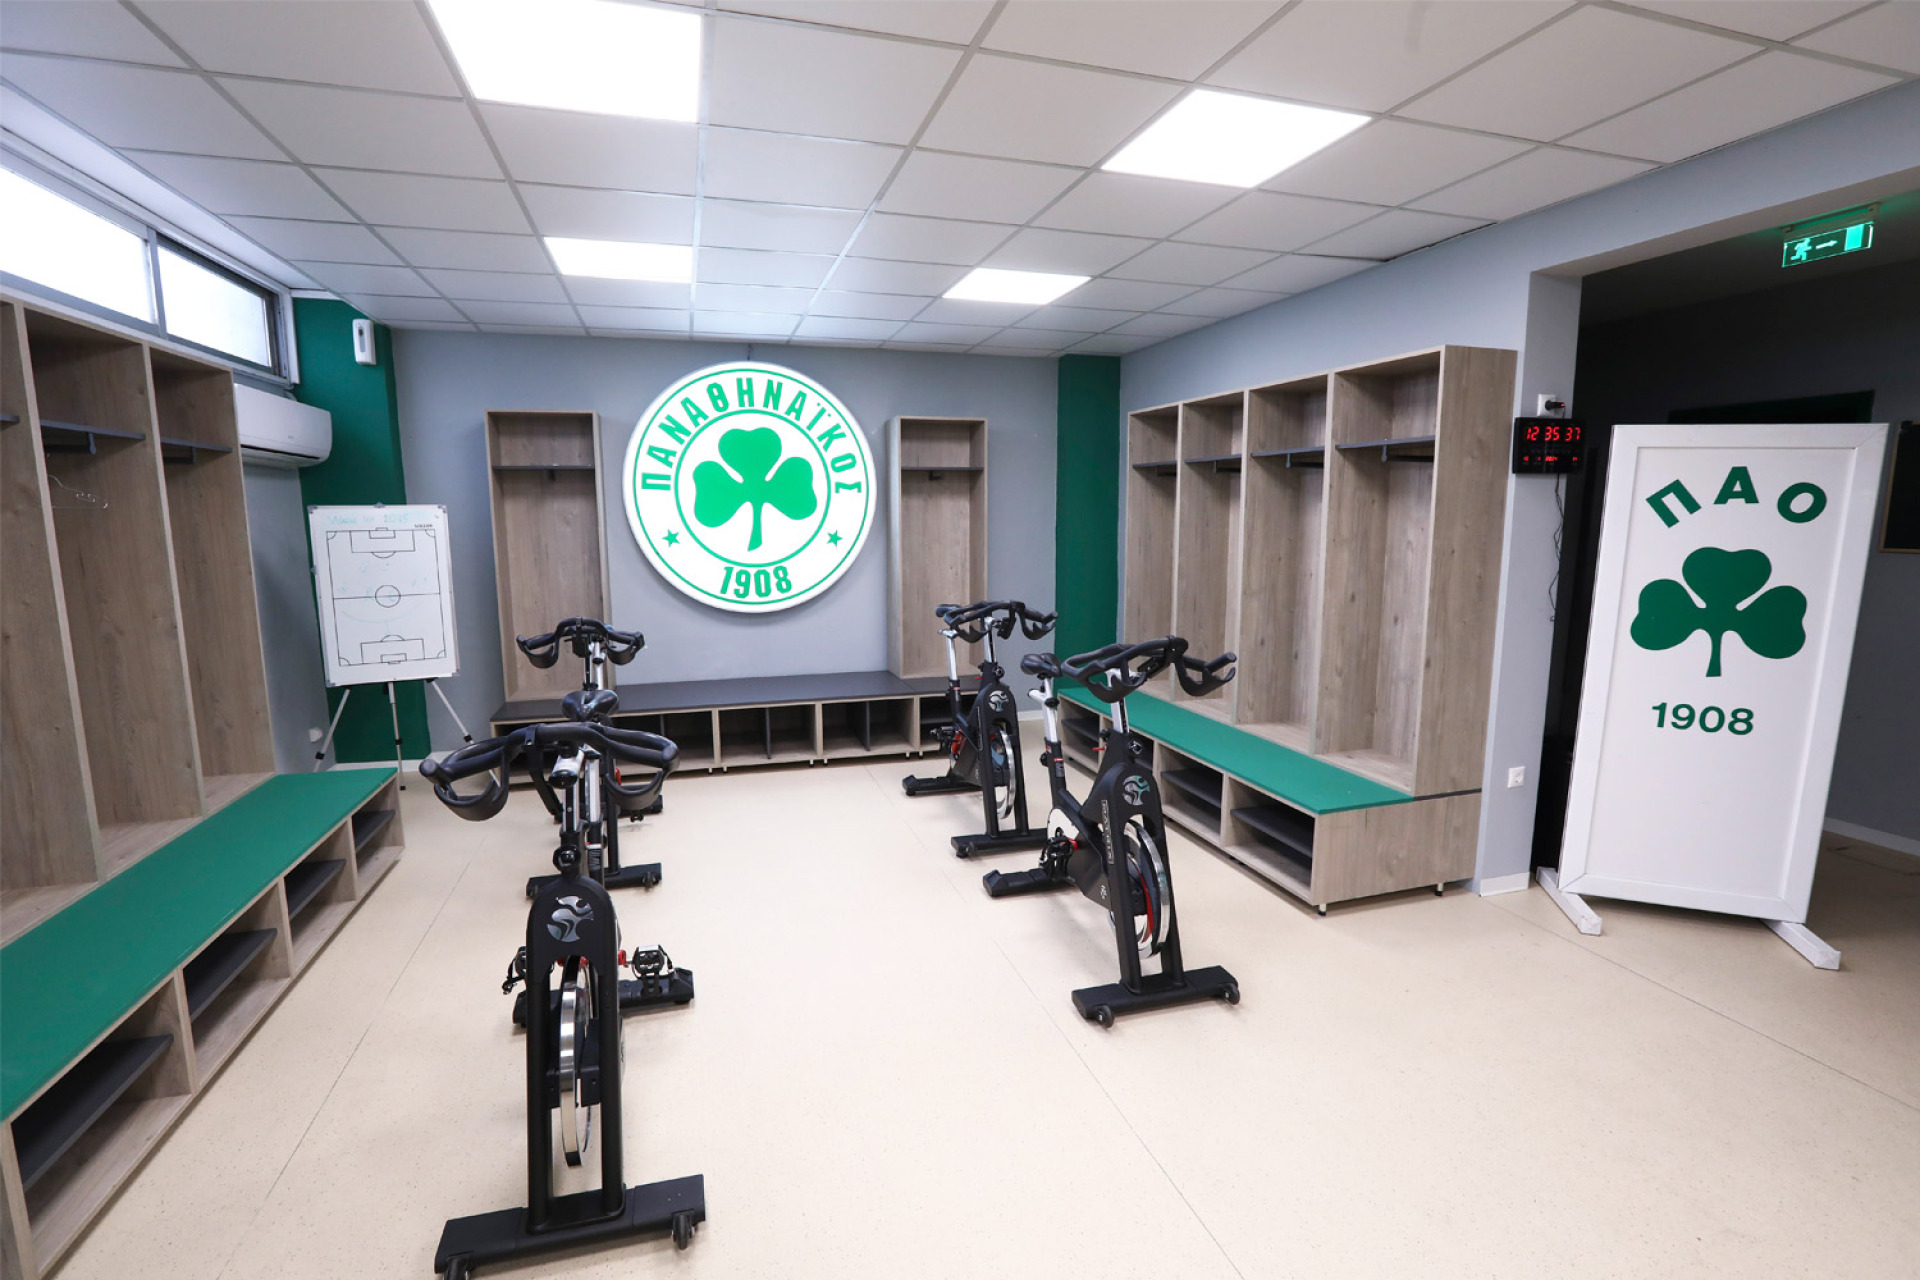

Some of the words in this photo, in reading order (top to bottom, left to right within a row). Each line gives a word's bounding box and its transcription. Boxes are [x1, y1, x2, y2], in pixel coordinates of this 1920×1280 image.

[641, 377, 862, 494] ΠΑΝΑΘΗΝΑΪΚΟΣ
[1526, 426, 1540, 441] 12
[1544, 426, 1560, 441] 35
[1564, 427, 1581, 442] 37
[1645, 466, 1827, 528] ΠΑΟ
[719, 565, 793, 599] 1908
[1652, 702, 1754, 736] 1908
